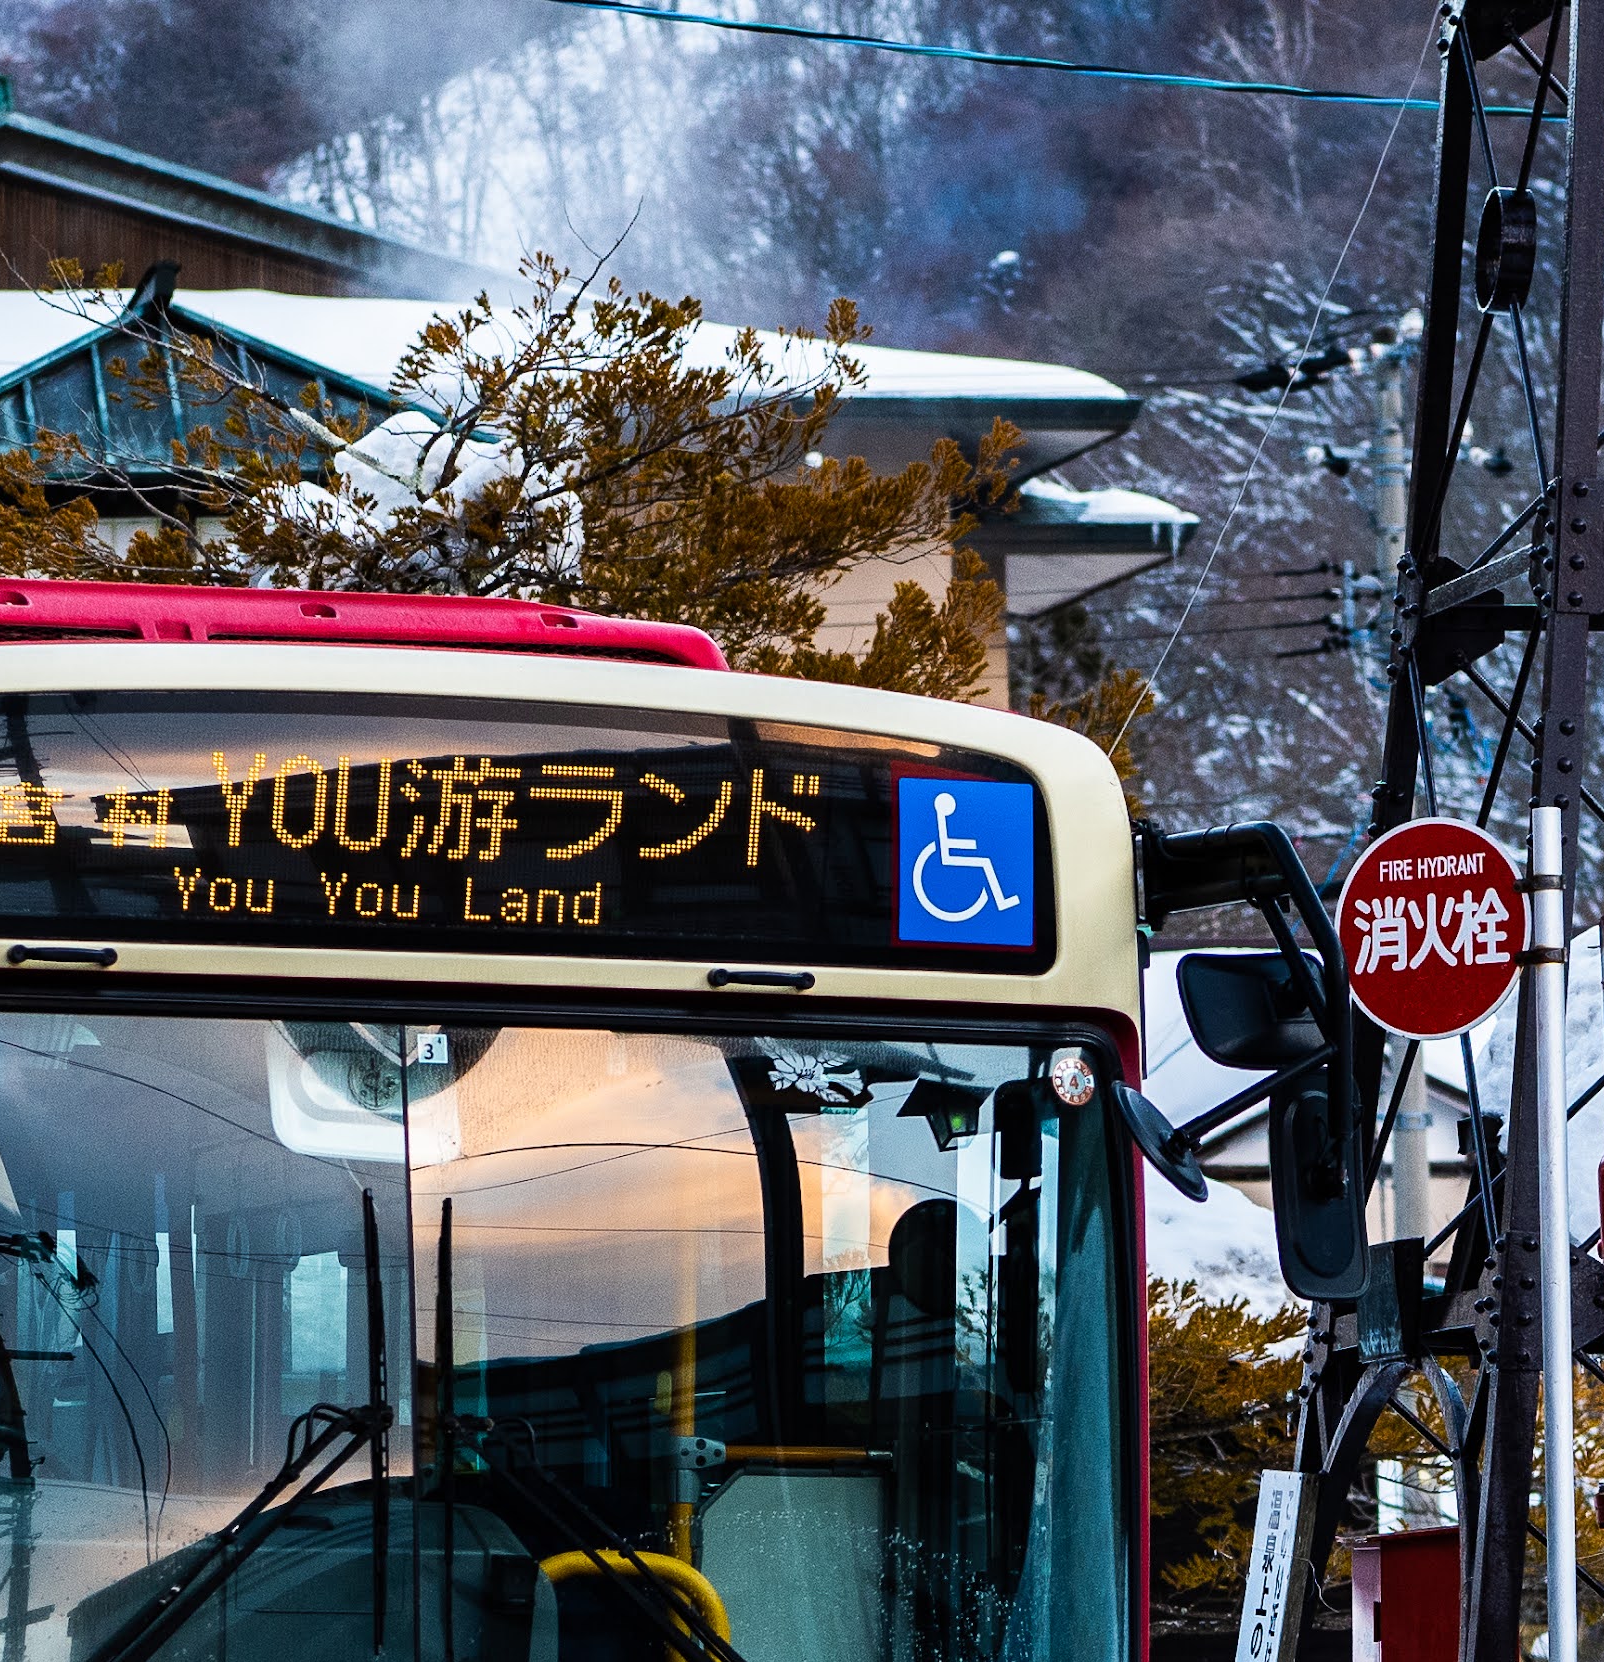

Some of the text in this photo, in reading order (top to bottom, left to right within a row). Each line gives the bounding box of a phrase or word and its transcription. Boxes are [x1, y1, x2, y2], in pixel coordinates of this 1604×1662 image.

[1379, 852, 1487, 883] FIRE HYDRANT
[174, 866, 602, 926] You You Land
[1353, 886, 1511, 976] 消火栓
[423, 1043, 434, 1060] 3
